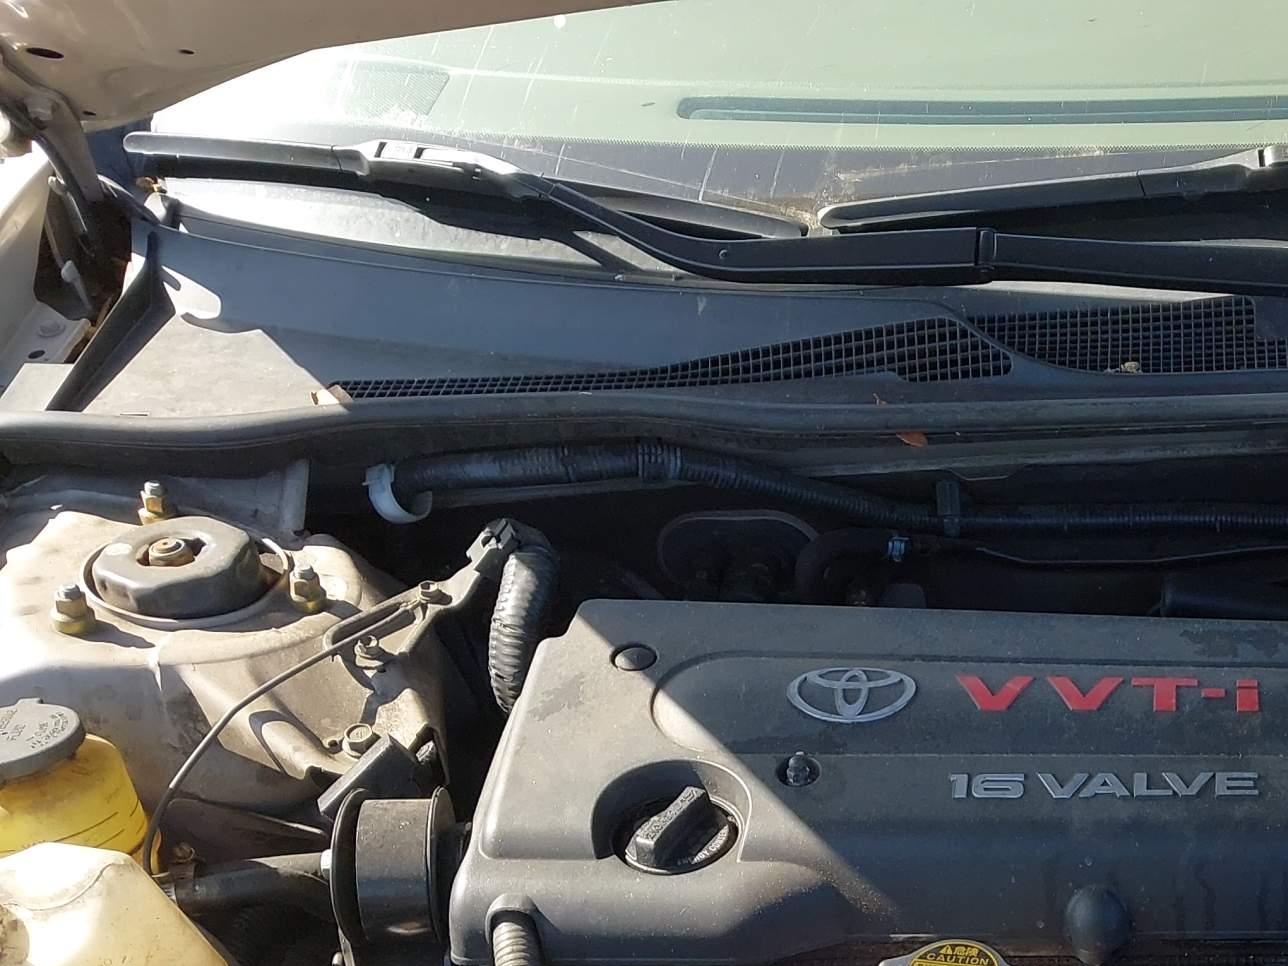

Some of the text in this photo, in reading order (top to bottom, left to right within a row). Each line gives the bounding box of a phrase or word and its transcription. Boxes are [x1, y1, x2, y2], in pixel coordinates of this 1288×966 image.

[957, 673, 1263, 713] VVT-i
[949, 772, 1259, 799] 16 VALVE
[926, 953, 990, 966] CAUTION
